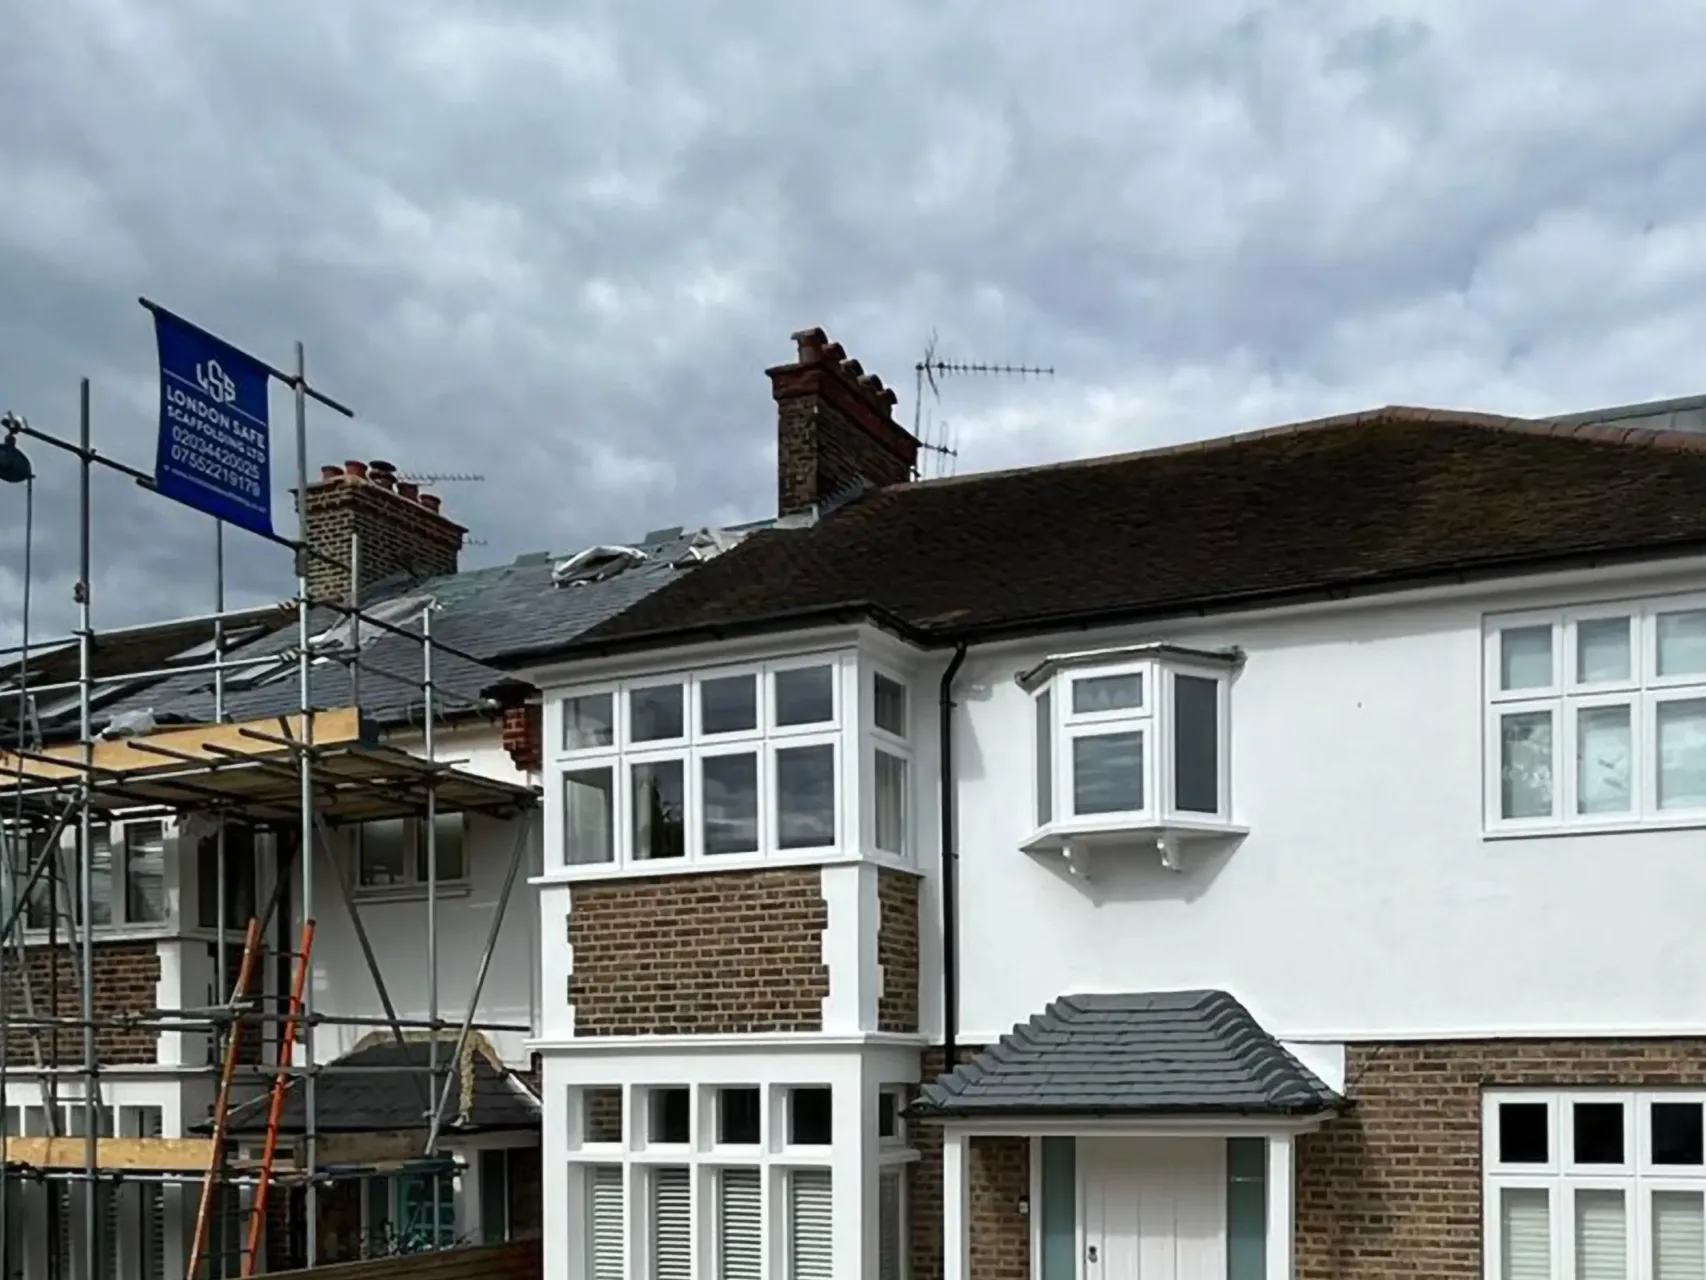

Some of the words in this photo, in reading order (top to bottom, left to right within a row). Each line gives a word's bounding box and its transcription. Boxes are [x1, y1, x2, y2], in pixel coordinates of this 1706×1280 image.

[166, 384, 230, 429] LONDON
[233, 420, 266, 449] SAFE
[167, 405, 245, 453] SCAFFOLDING
